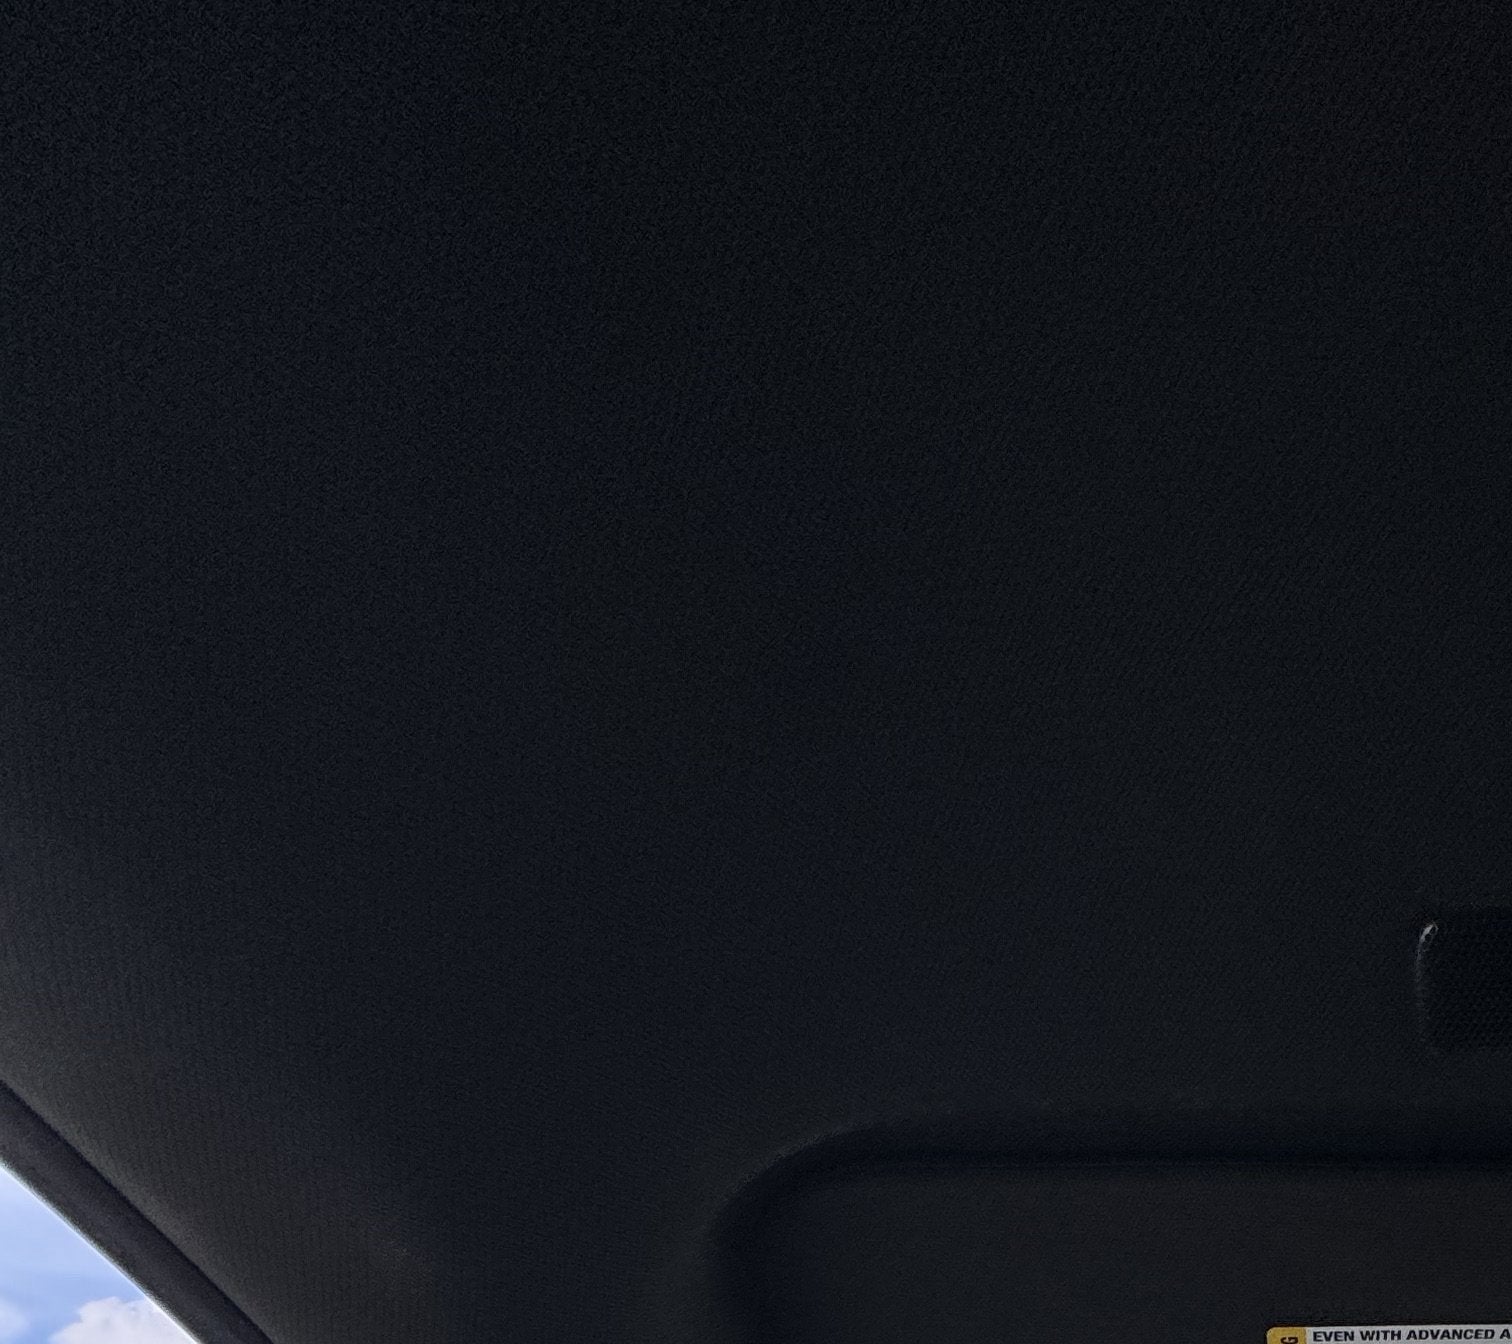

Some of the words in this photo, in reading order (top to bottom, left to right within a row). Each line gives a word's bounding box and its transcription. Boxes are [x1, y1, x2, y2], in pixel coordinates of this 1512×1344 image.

[1312, 1331, 1355, 1342] EVEN
[1360, 1330, 1402, 1341] WITH
[1406, 1329, 1495, 1341] ADVANCED
